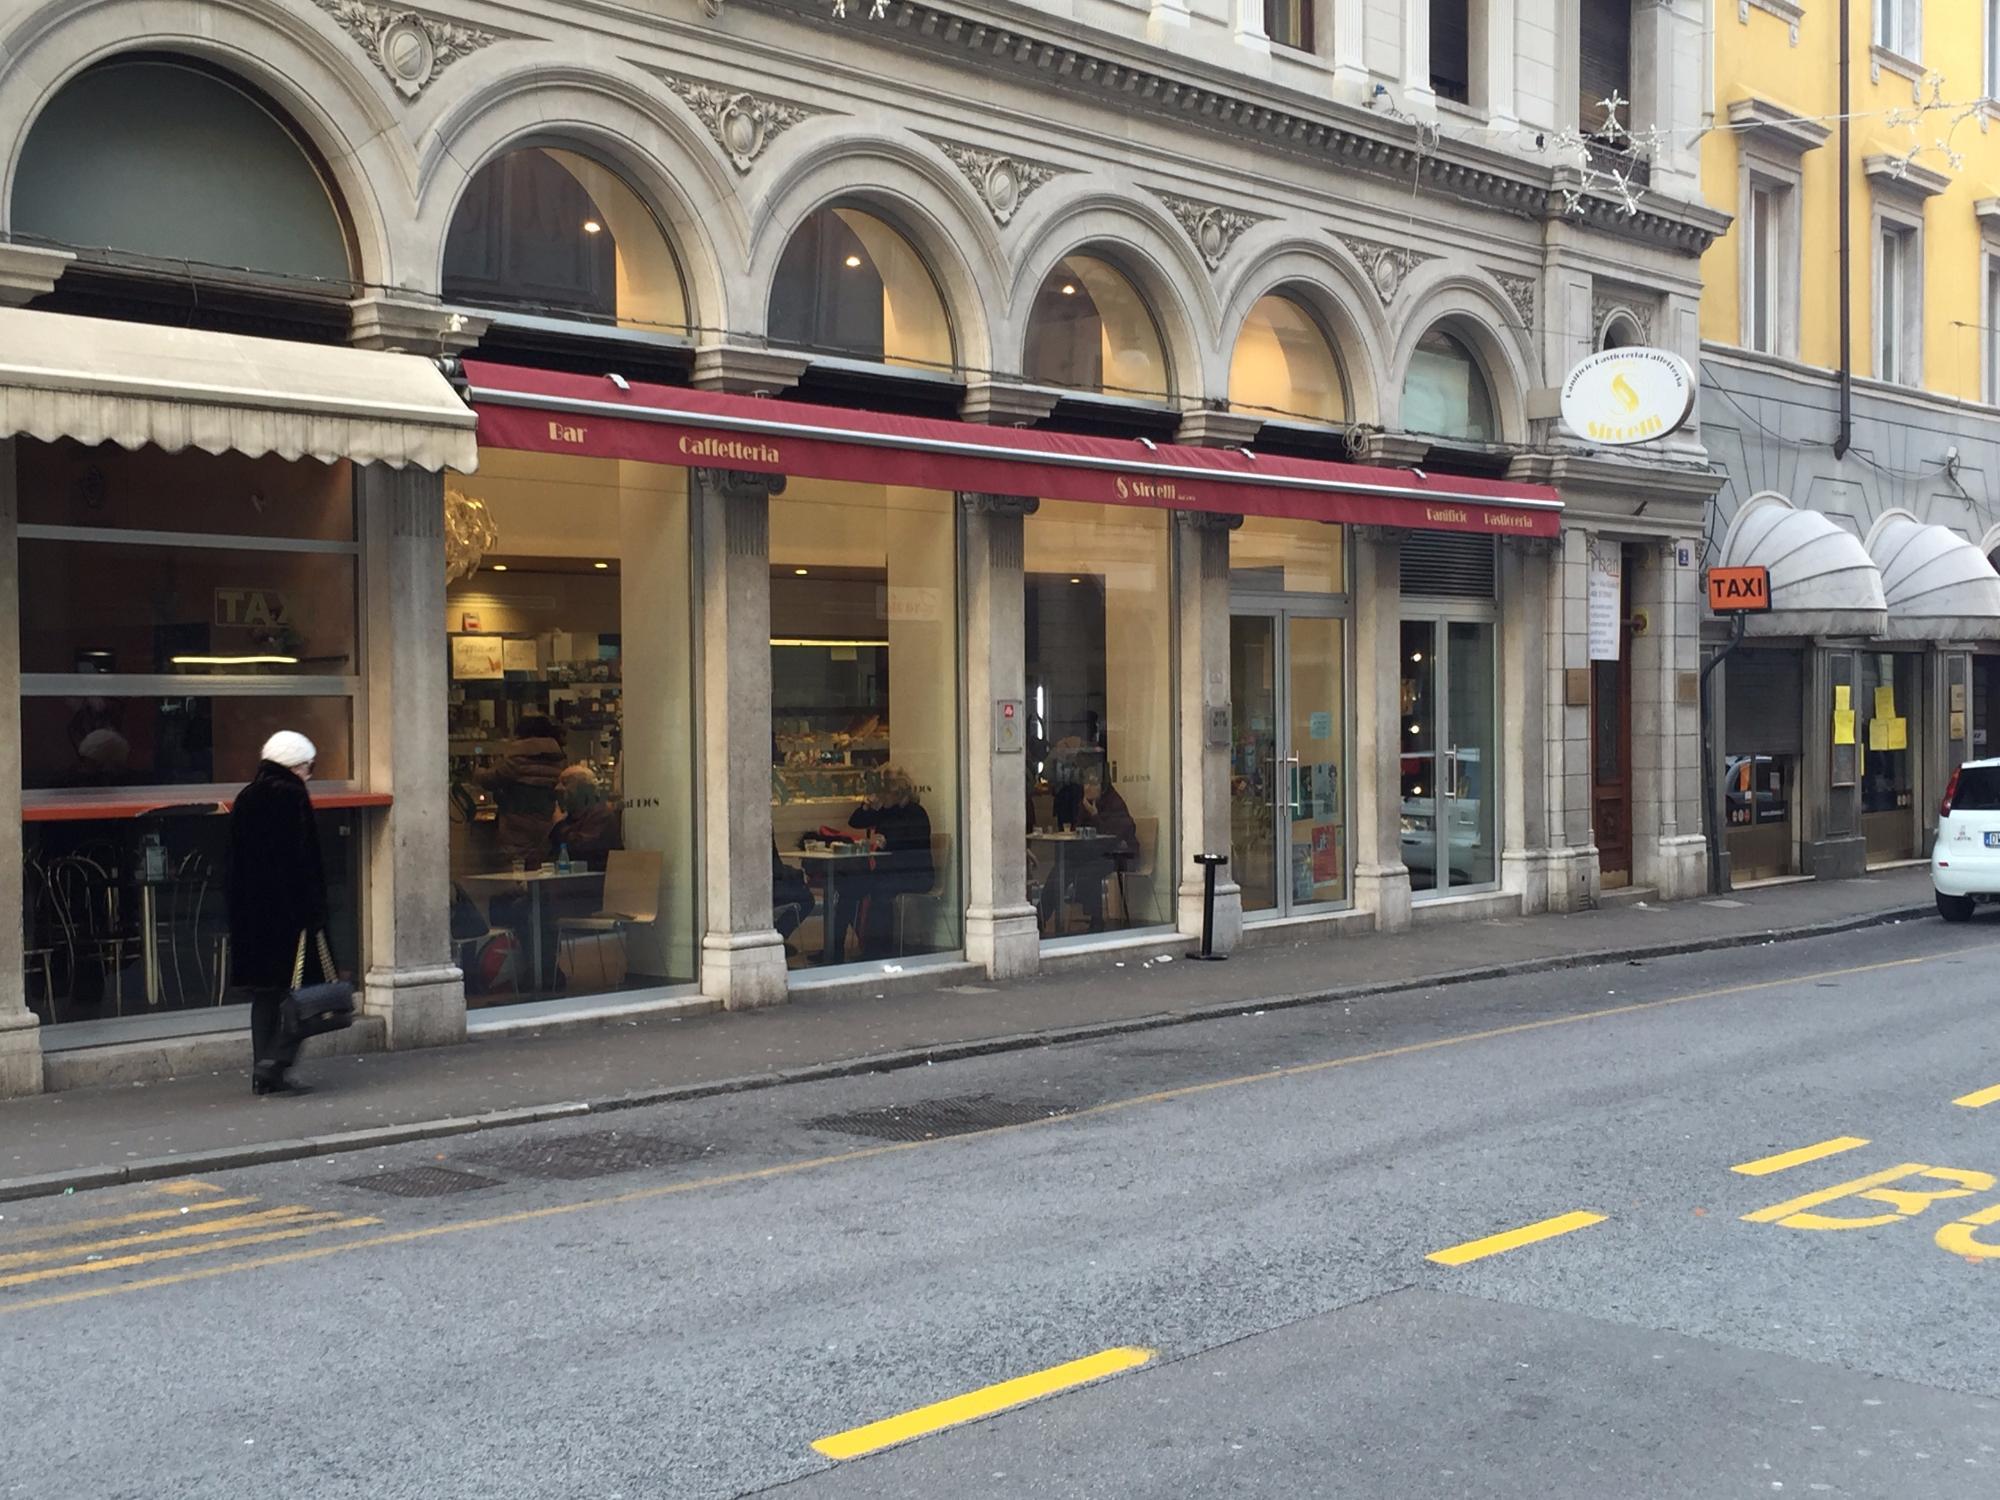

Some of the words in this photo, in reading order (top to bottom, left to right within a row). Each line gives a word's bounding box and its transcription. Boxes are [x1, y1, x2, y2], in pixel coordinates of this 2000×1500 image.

[548, 421, 587, 444] Bar
[1587, 414, 1662, 441] Sircelli
[679, 435, 779, 464] Caffetteria
[1132, 481, 1175, 500] Sircelli
[1484, 512, 1533, 528] Pasticceria
[1712, 577, 1762, 598] TAXI
